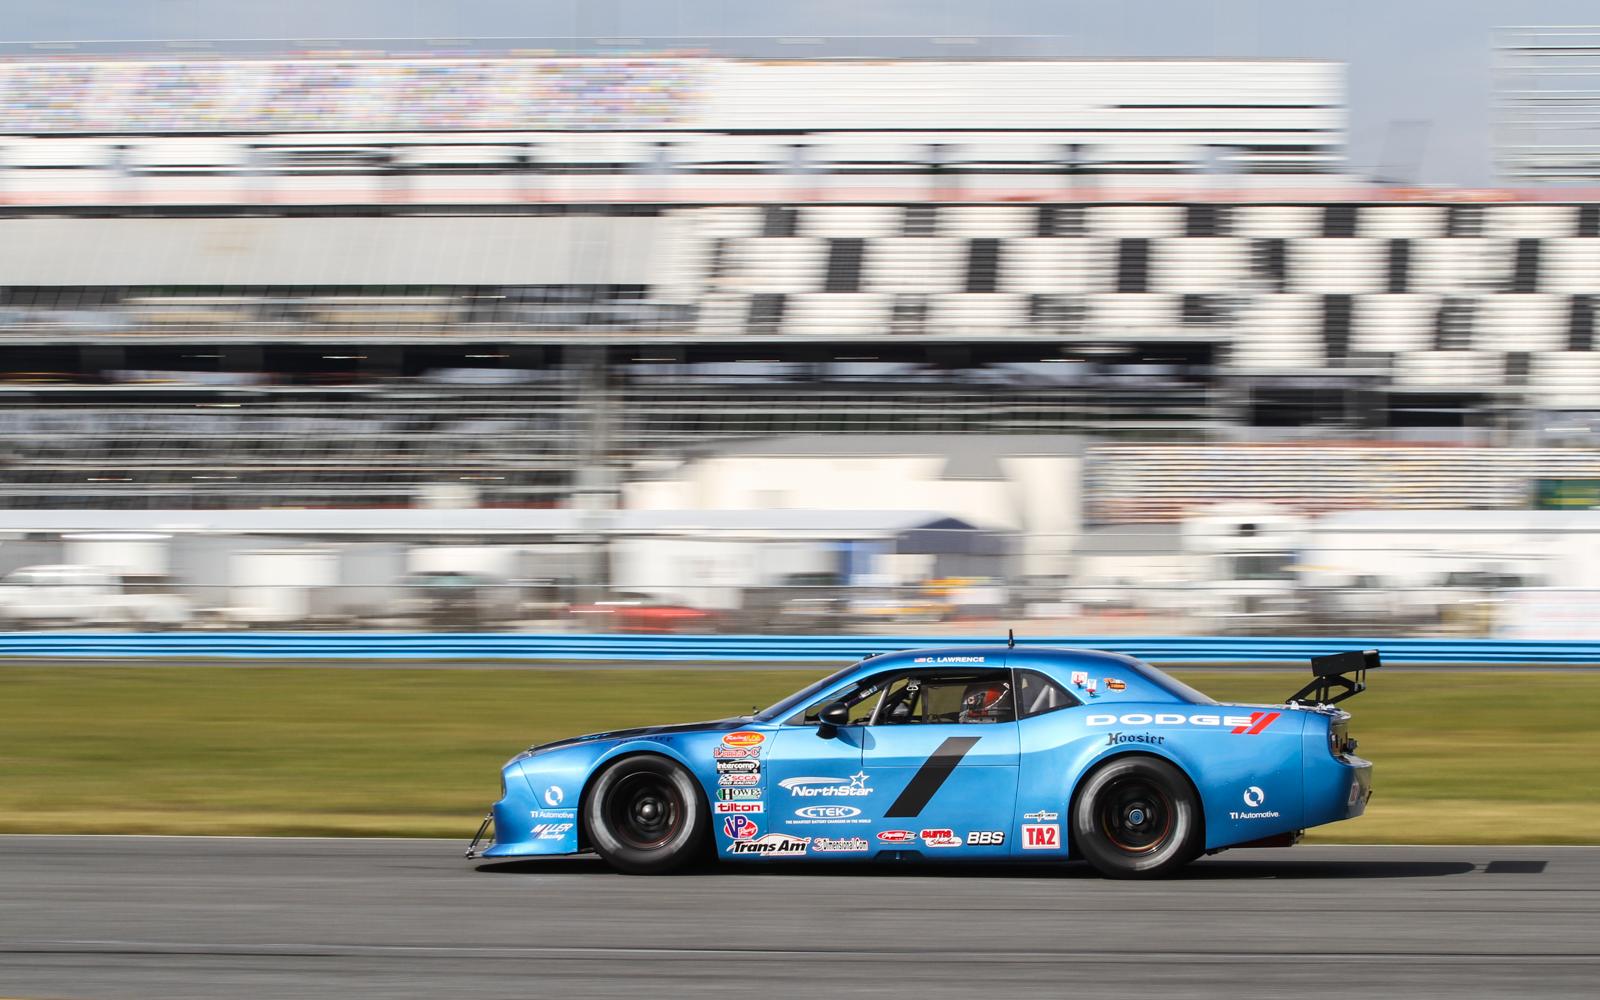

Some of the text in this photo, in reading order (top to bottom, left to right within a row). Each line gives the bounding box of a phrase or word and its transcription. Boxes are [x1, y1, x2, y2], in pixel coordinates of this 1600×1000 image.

[1086, 713, 1253, 727] DODGE
[1106, 731, 1165, 746] Hoosier
[717, 762, 754, 770] Intercomp
[791, 785, 874, 796] NorthStar
[717, 803, 760, 812] tilton
[807, 808, 843, 817] CTEK
[725, 815, 747, 838] VP
[967, 831, 1004, 845] BBS
[1026, 828, 1056, 845] TA2
[734, 840, 807, 853] Trans Am
